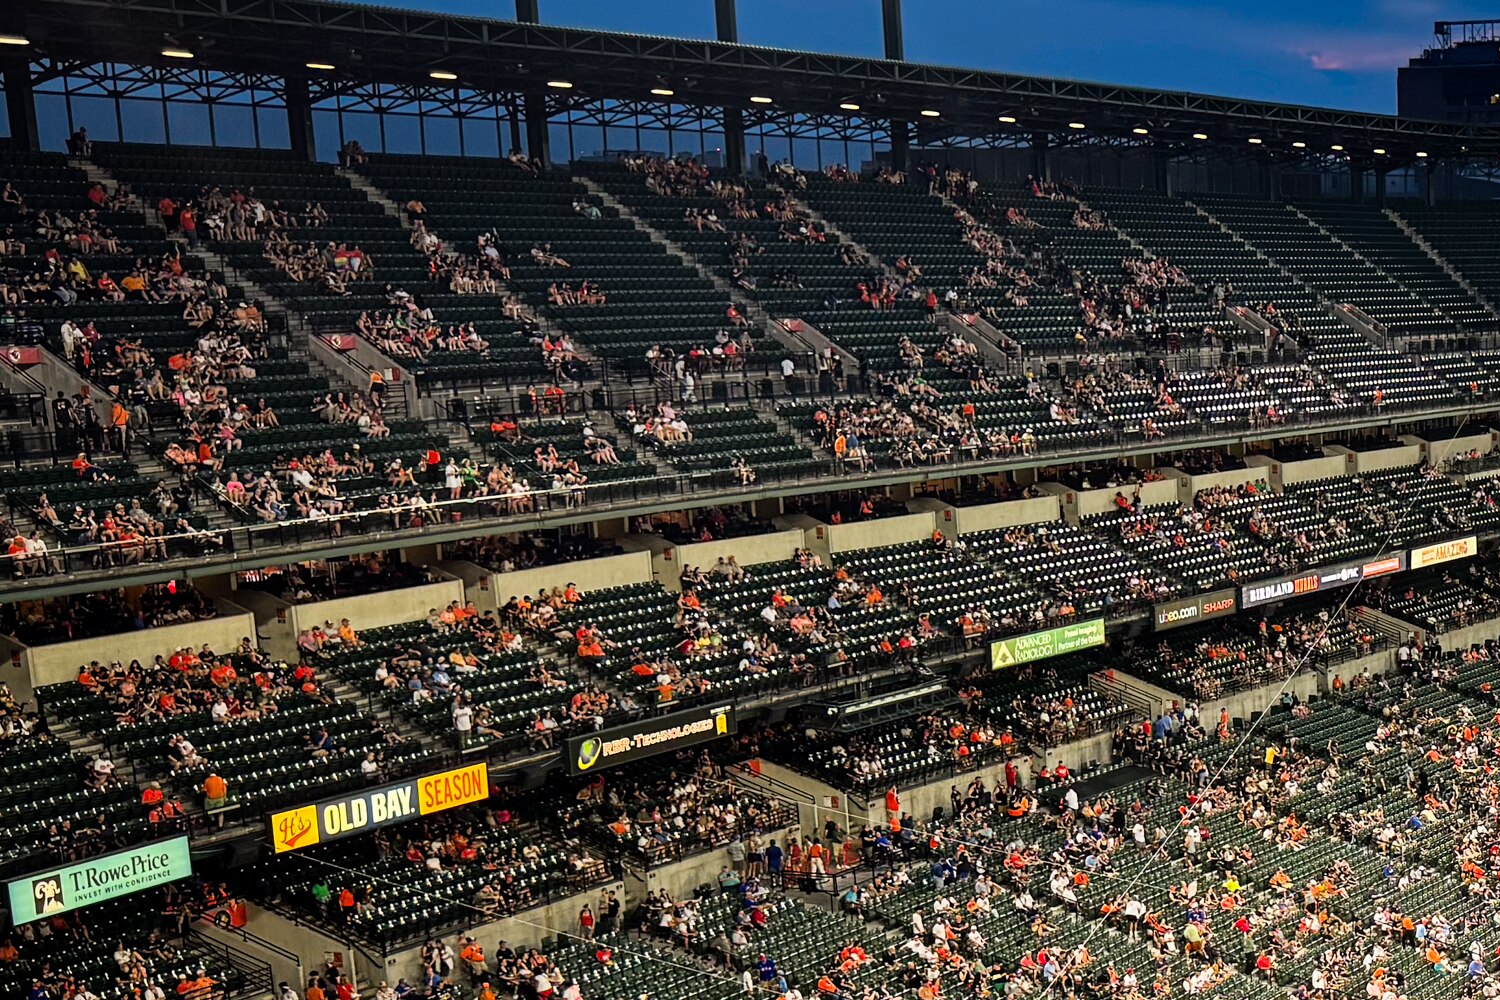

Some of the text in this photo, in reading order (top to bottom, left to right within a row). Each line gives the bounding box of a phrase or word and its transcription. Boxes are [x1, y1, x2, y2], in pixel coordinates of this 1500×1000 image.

[1250, 581, 1294, 602] BIRDLAND
[1159, 598, 1234, 624] ubeo.com SHARP
[1015, 644, 1054, 663] RADIOLOGY
[1016, 634, 1052, 650] ADVANCED
[323, 800, 367, 836] OLD
[424, 768, 483, 808] SEASON
[74, 870, 171, 902] INVEST WITH CONFIDENCE
